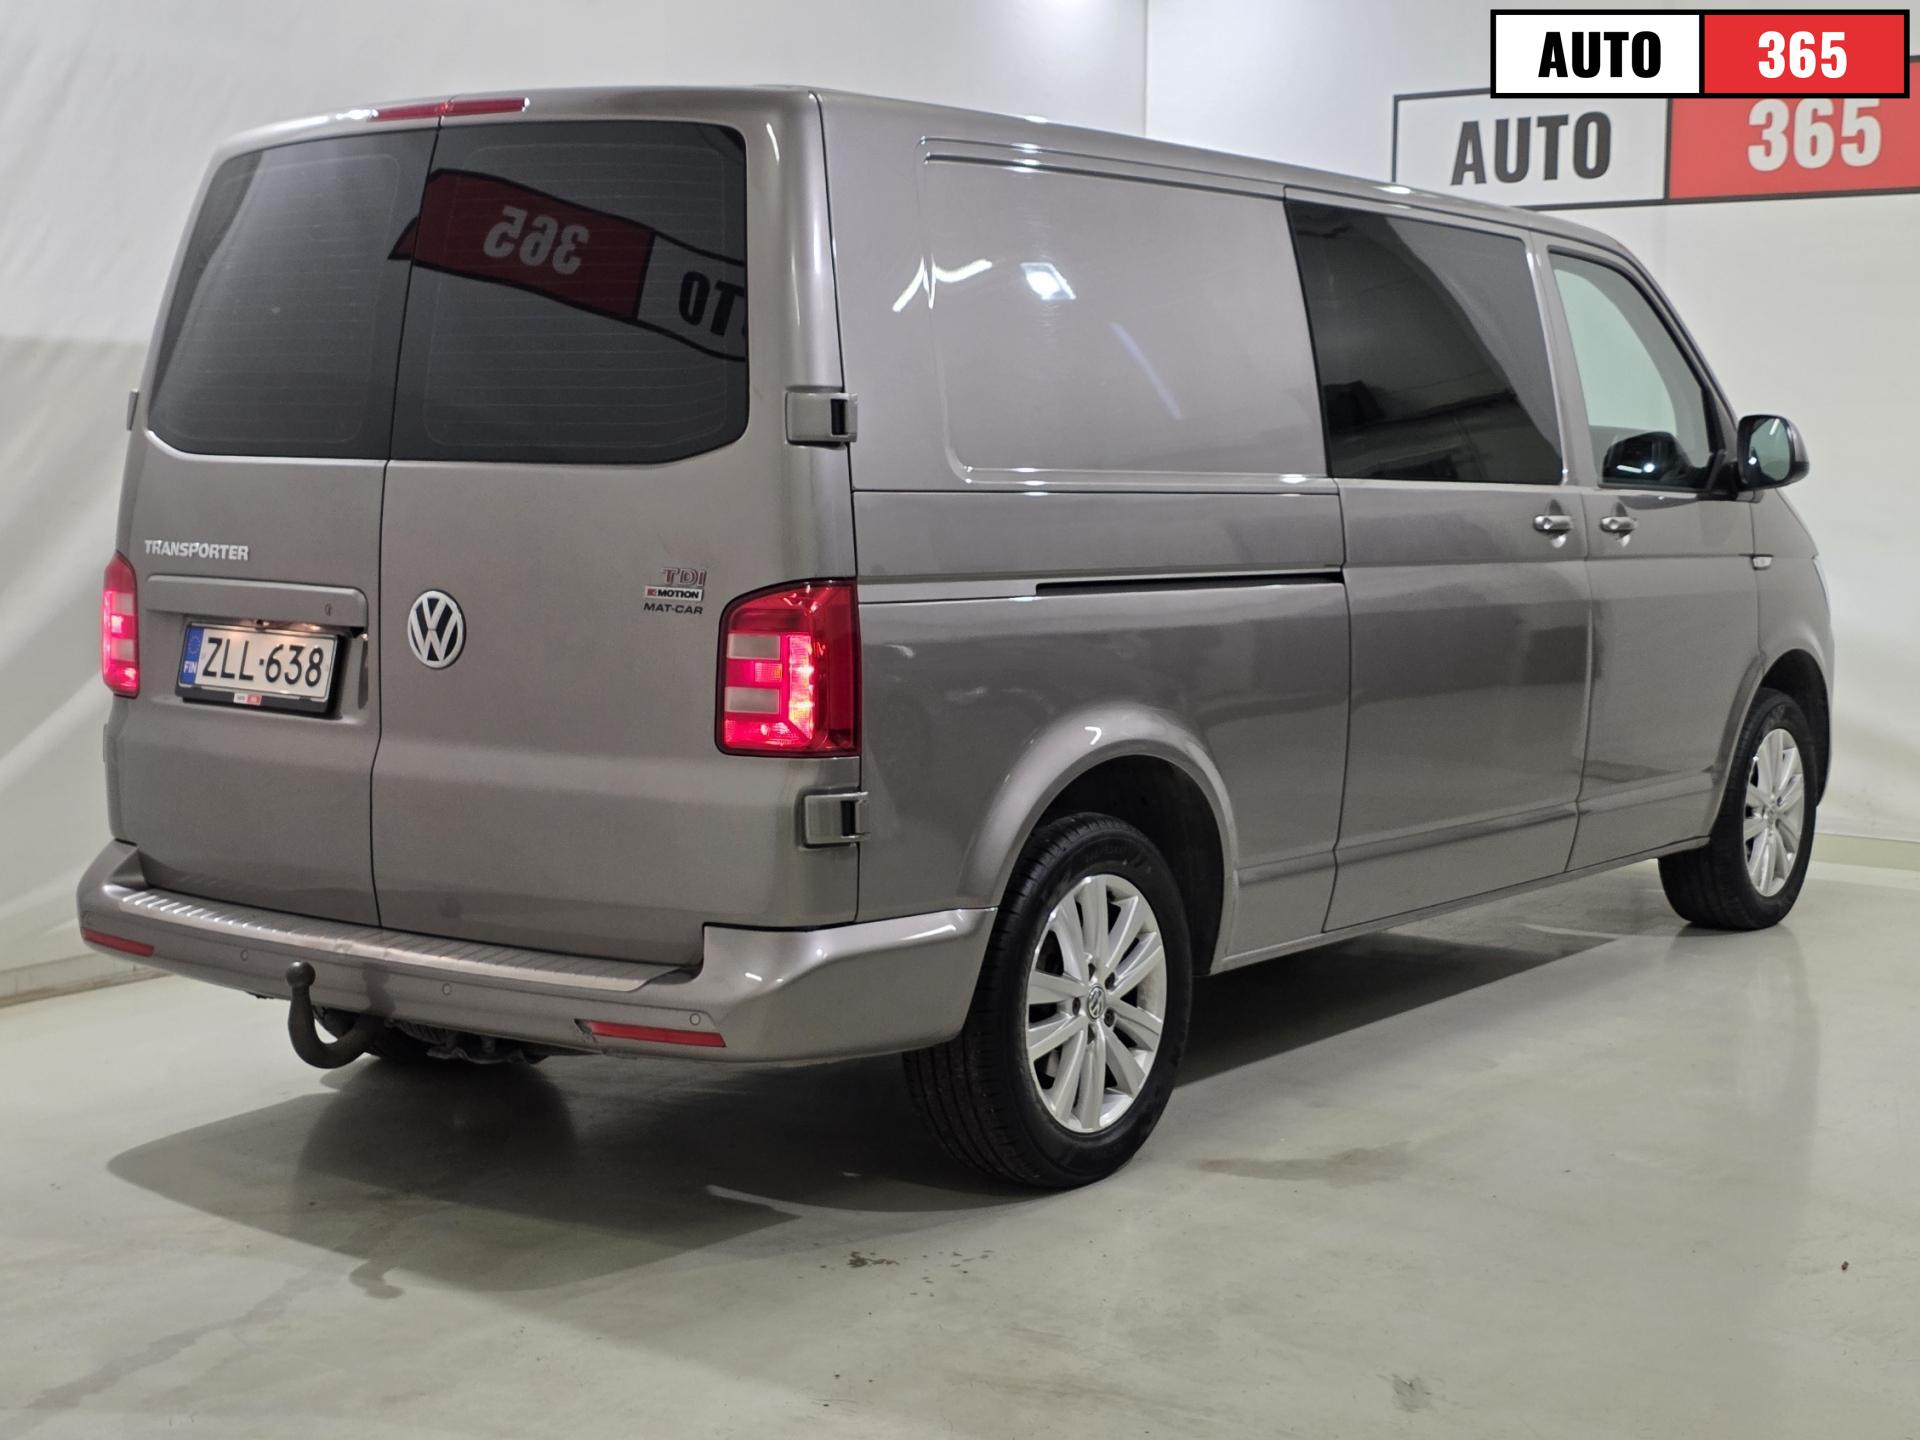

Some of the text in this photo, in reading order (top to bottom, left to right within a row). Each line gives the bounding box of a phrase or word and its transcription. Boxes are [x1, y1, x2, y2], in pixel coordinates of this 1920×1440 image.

[1450, 98, 1882, 186] AUTO 365
[144, 540, 249, 561] TRANSPORTER
[661, 566, 707, 588] TDI
[643, 602, 703, 615] MAT-CAR
[183, 660, 197, 674] FIN
[202, 637, 324, 687] ZLL-638
